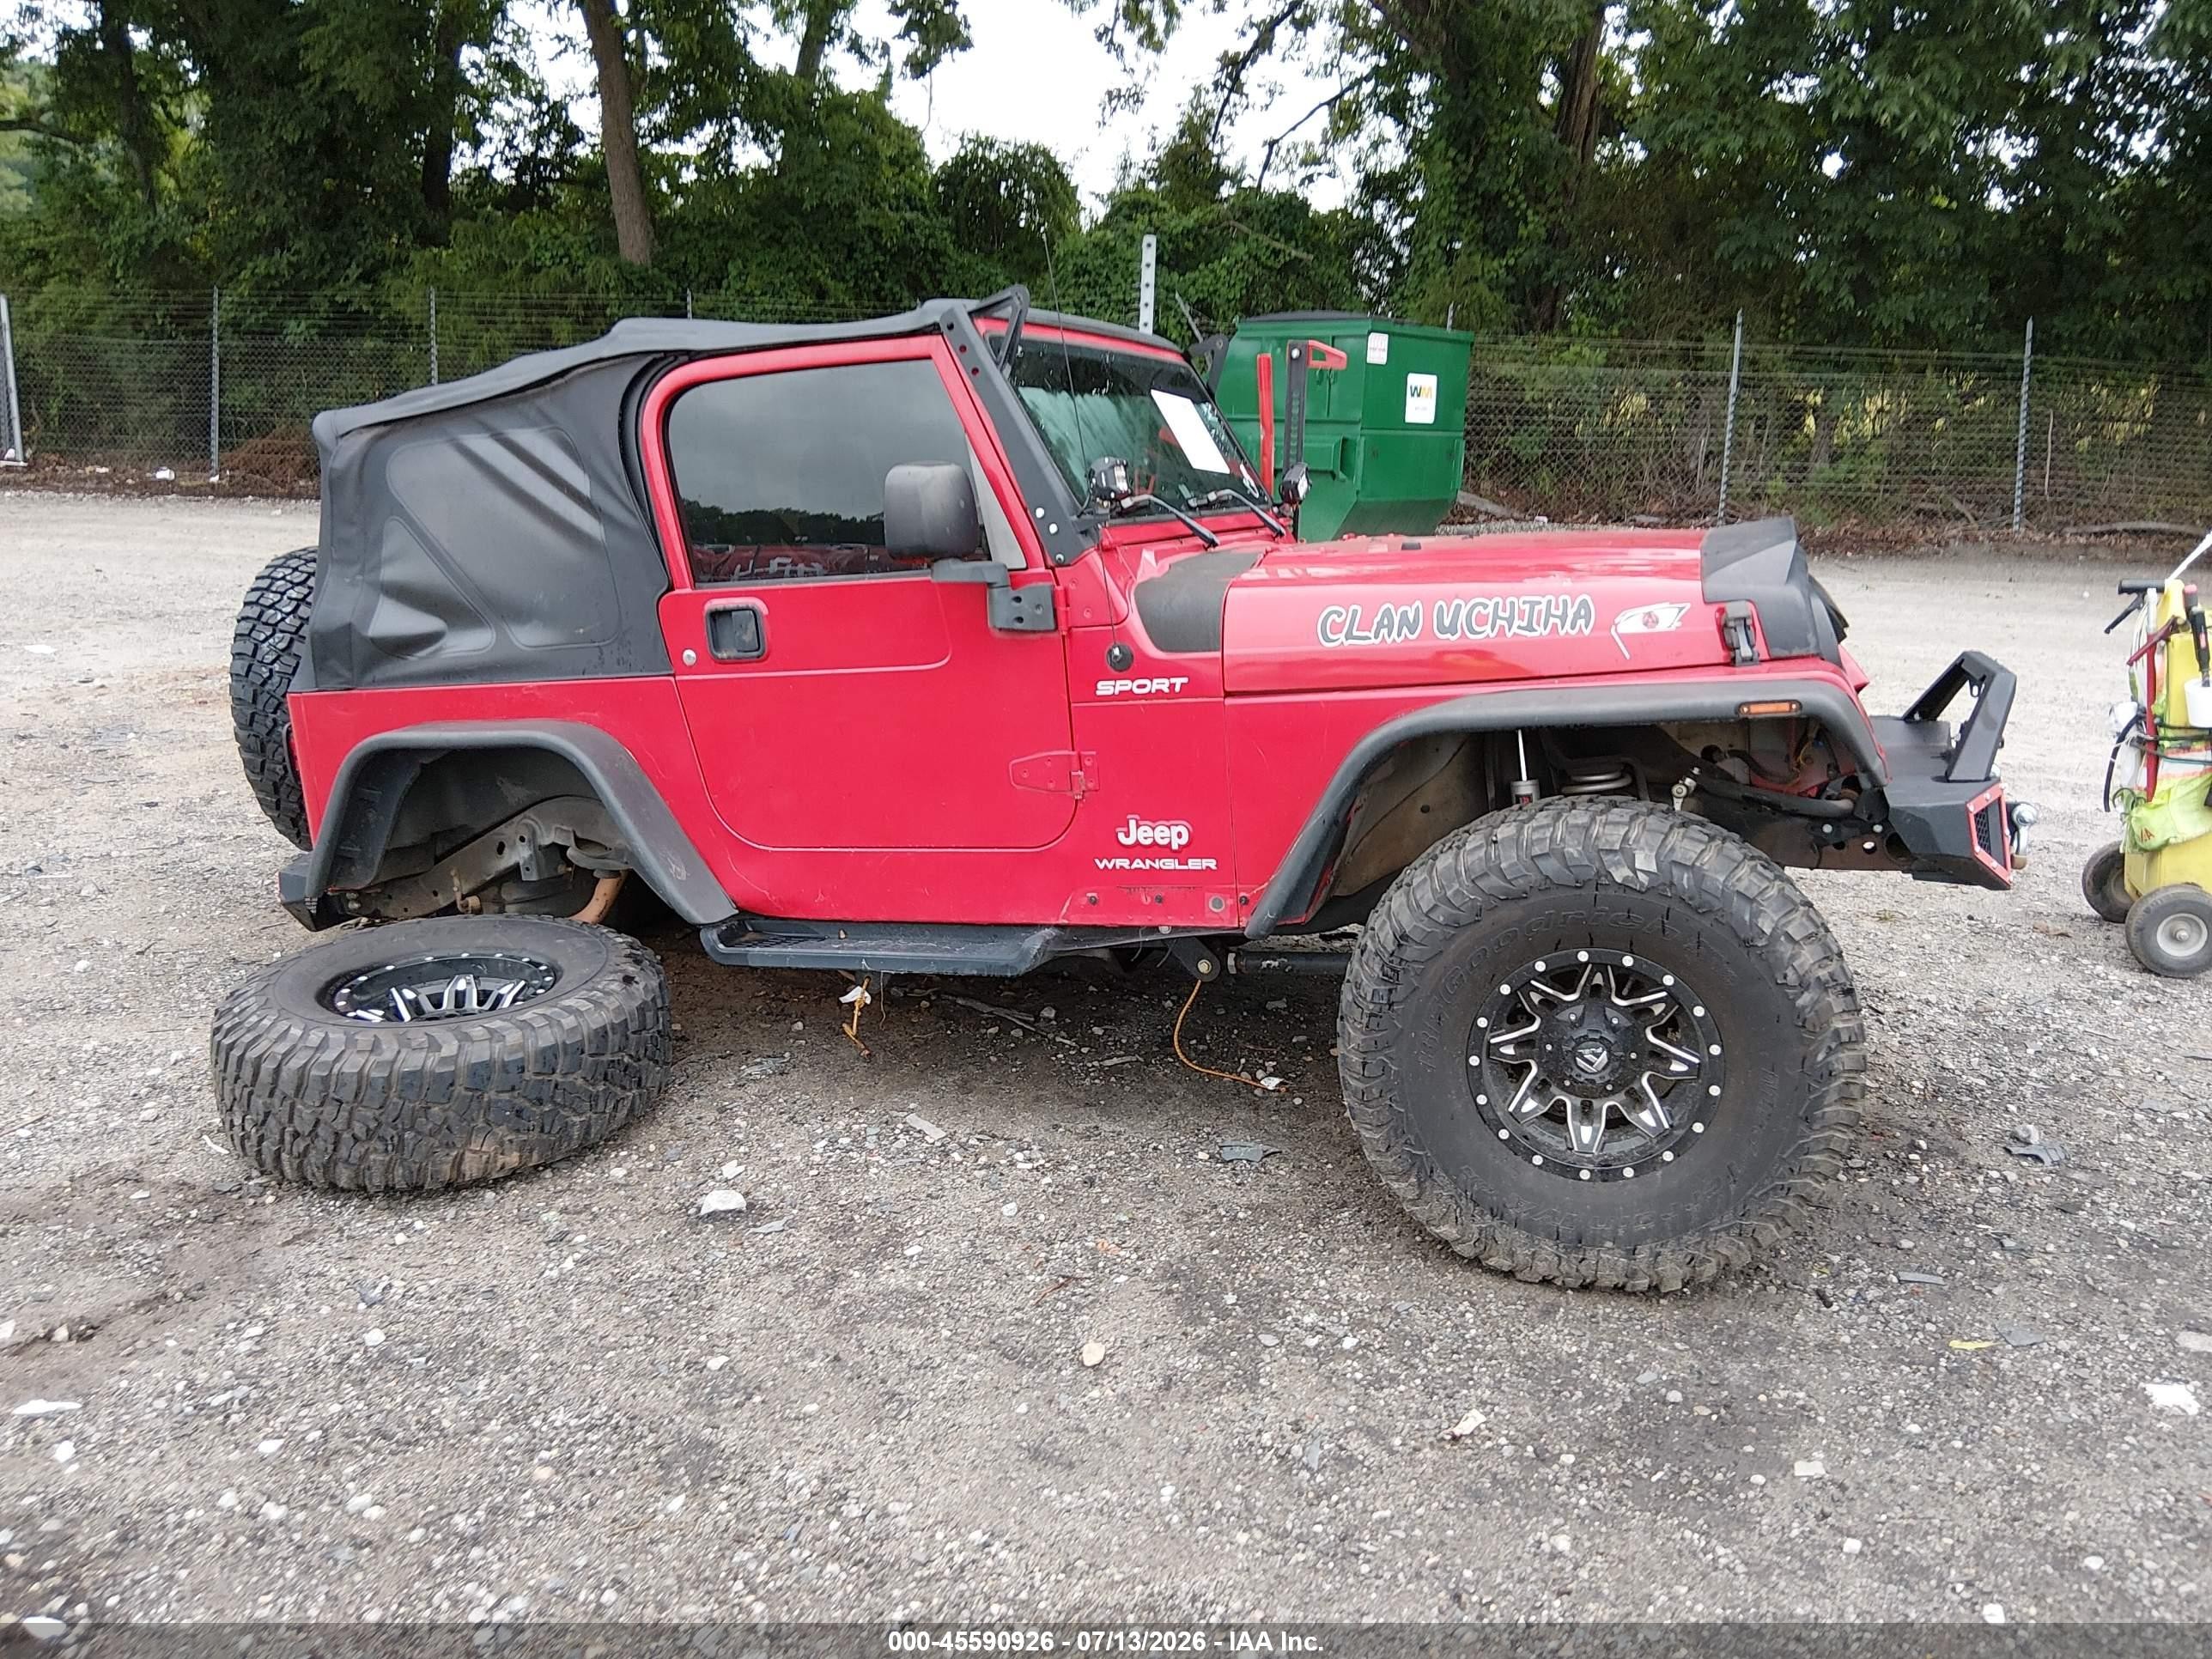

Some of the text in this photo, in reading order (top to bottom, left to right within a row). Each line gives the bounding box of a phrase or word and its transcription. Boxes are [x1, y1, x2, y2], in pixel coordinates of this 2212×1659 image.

[1410, 384, 1433, 399] WM
[1317, 592, 1595, 647] CLAN UCHIHA
[1096, 677, 1188, 696] SPORT
[1116, 815, 1192, 850] Jeep
[1094, 858, 1218, 871] WRANGLER
